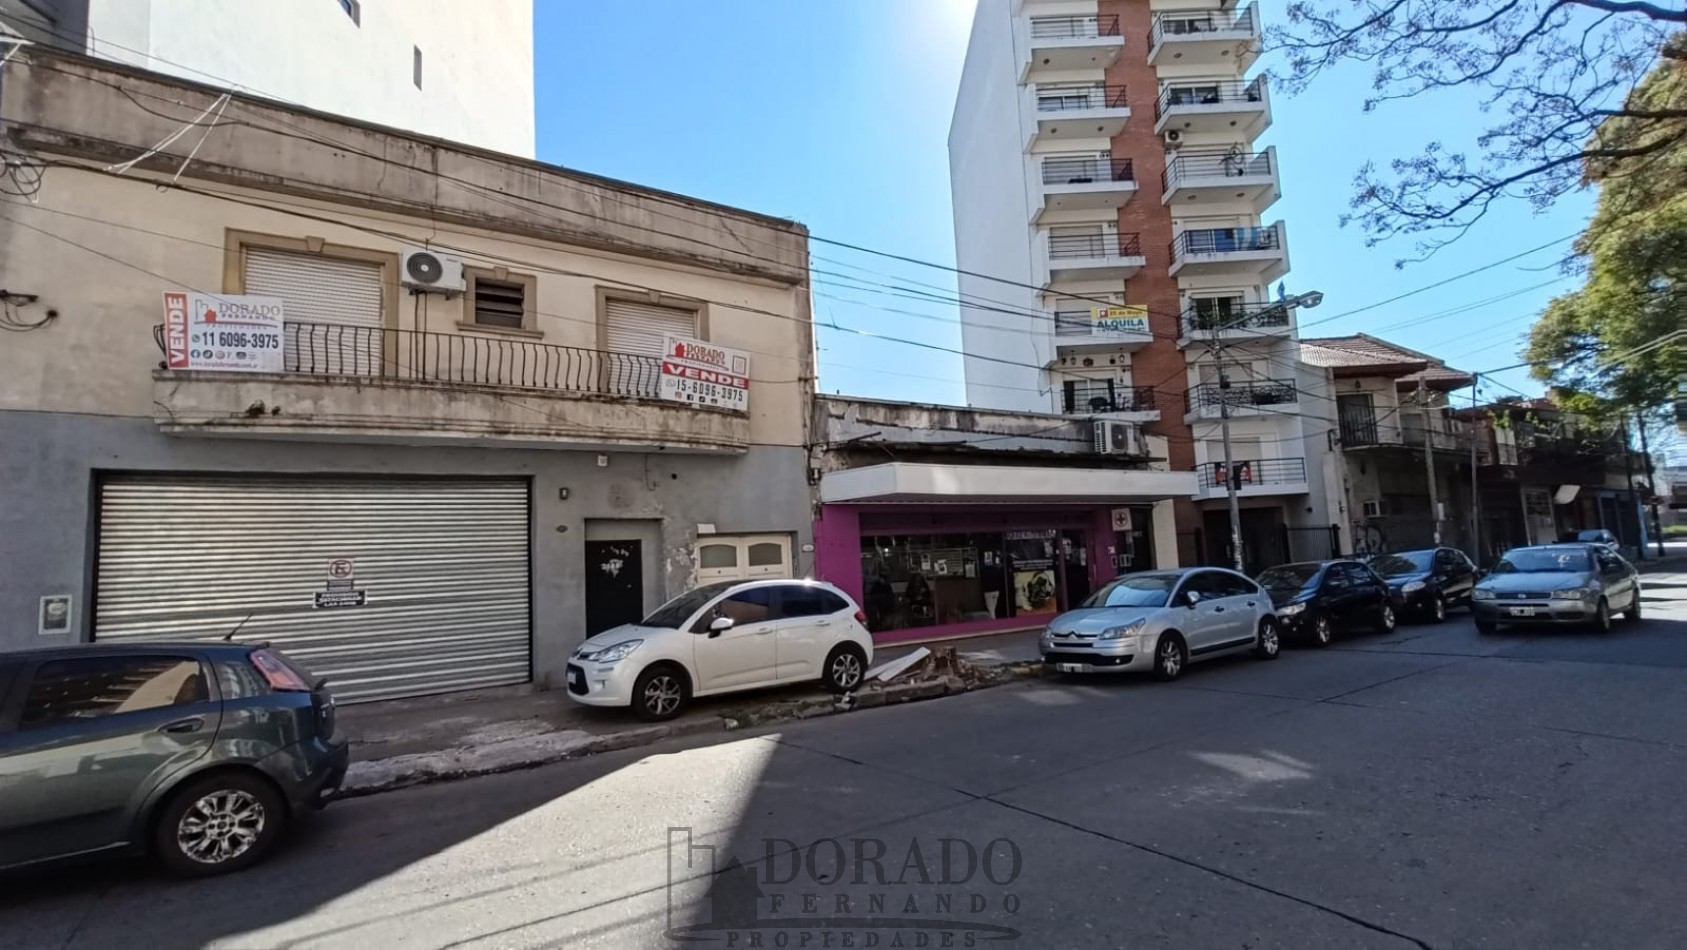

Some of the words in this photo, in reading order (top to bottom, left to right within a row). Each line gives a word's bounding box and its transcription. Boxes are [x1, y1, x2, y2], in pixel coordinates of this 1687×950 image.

[218, 303, 281, 316] DORADO
[167, 296, 186, 364] VENDE
[1097, 319, 1144, 330] ALQUILA
[202, 332, 215, 347] 11
[219, 332, 279, 349] 6096-3975
[686, 343, 725, 360] DORADO
[666, 364, 746, 388] VENDE
